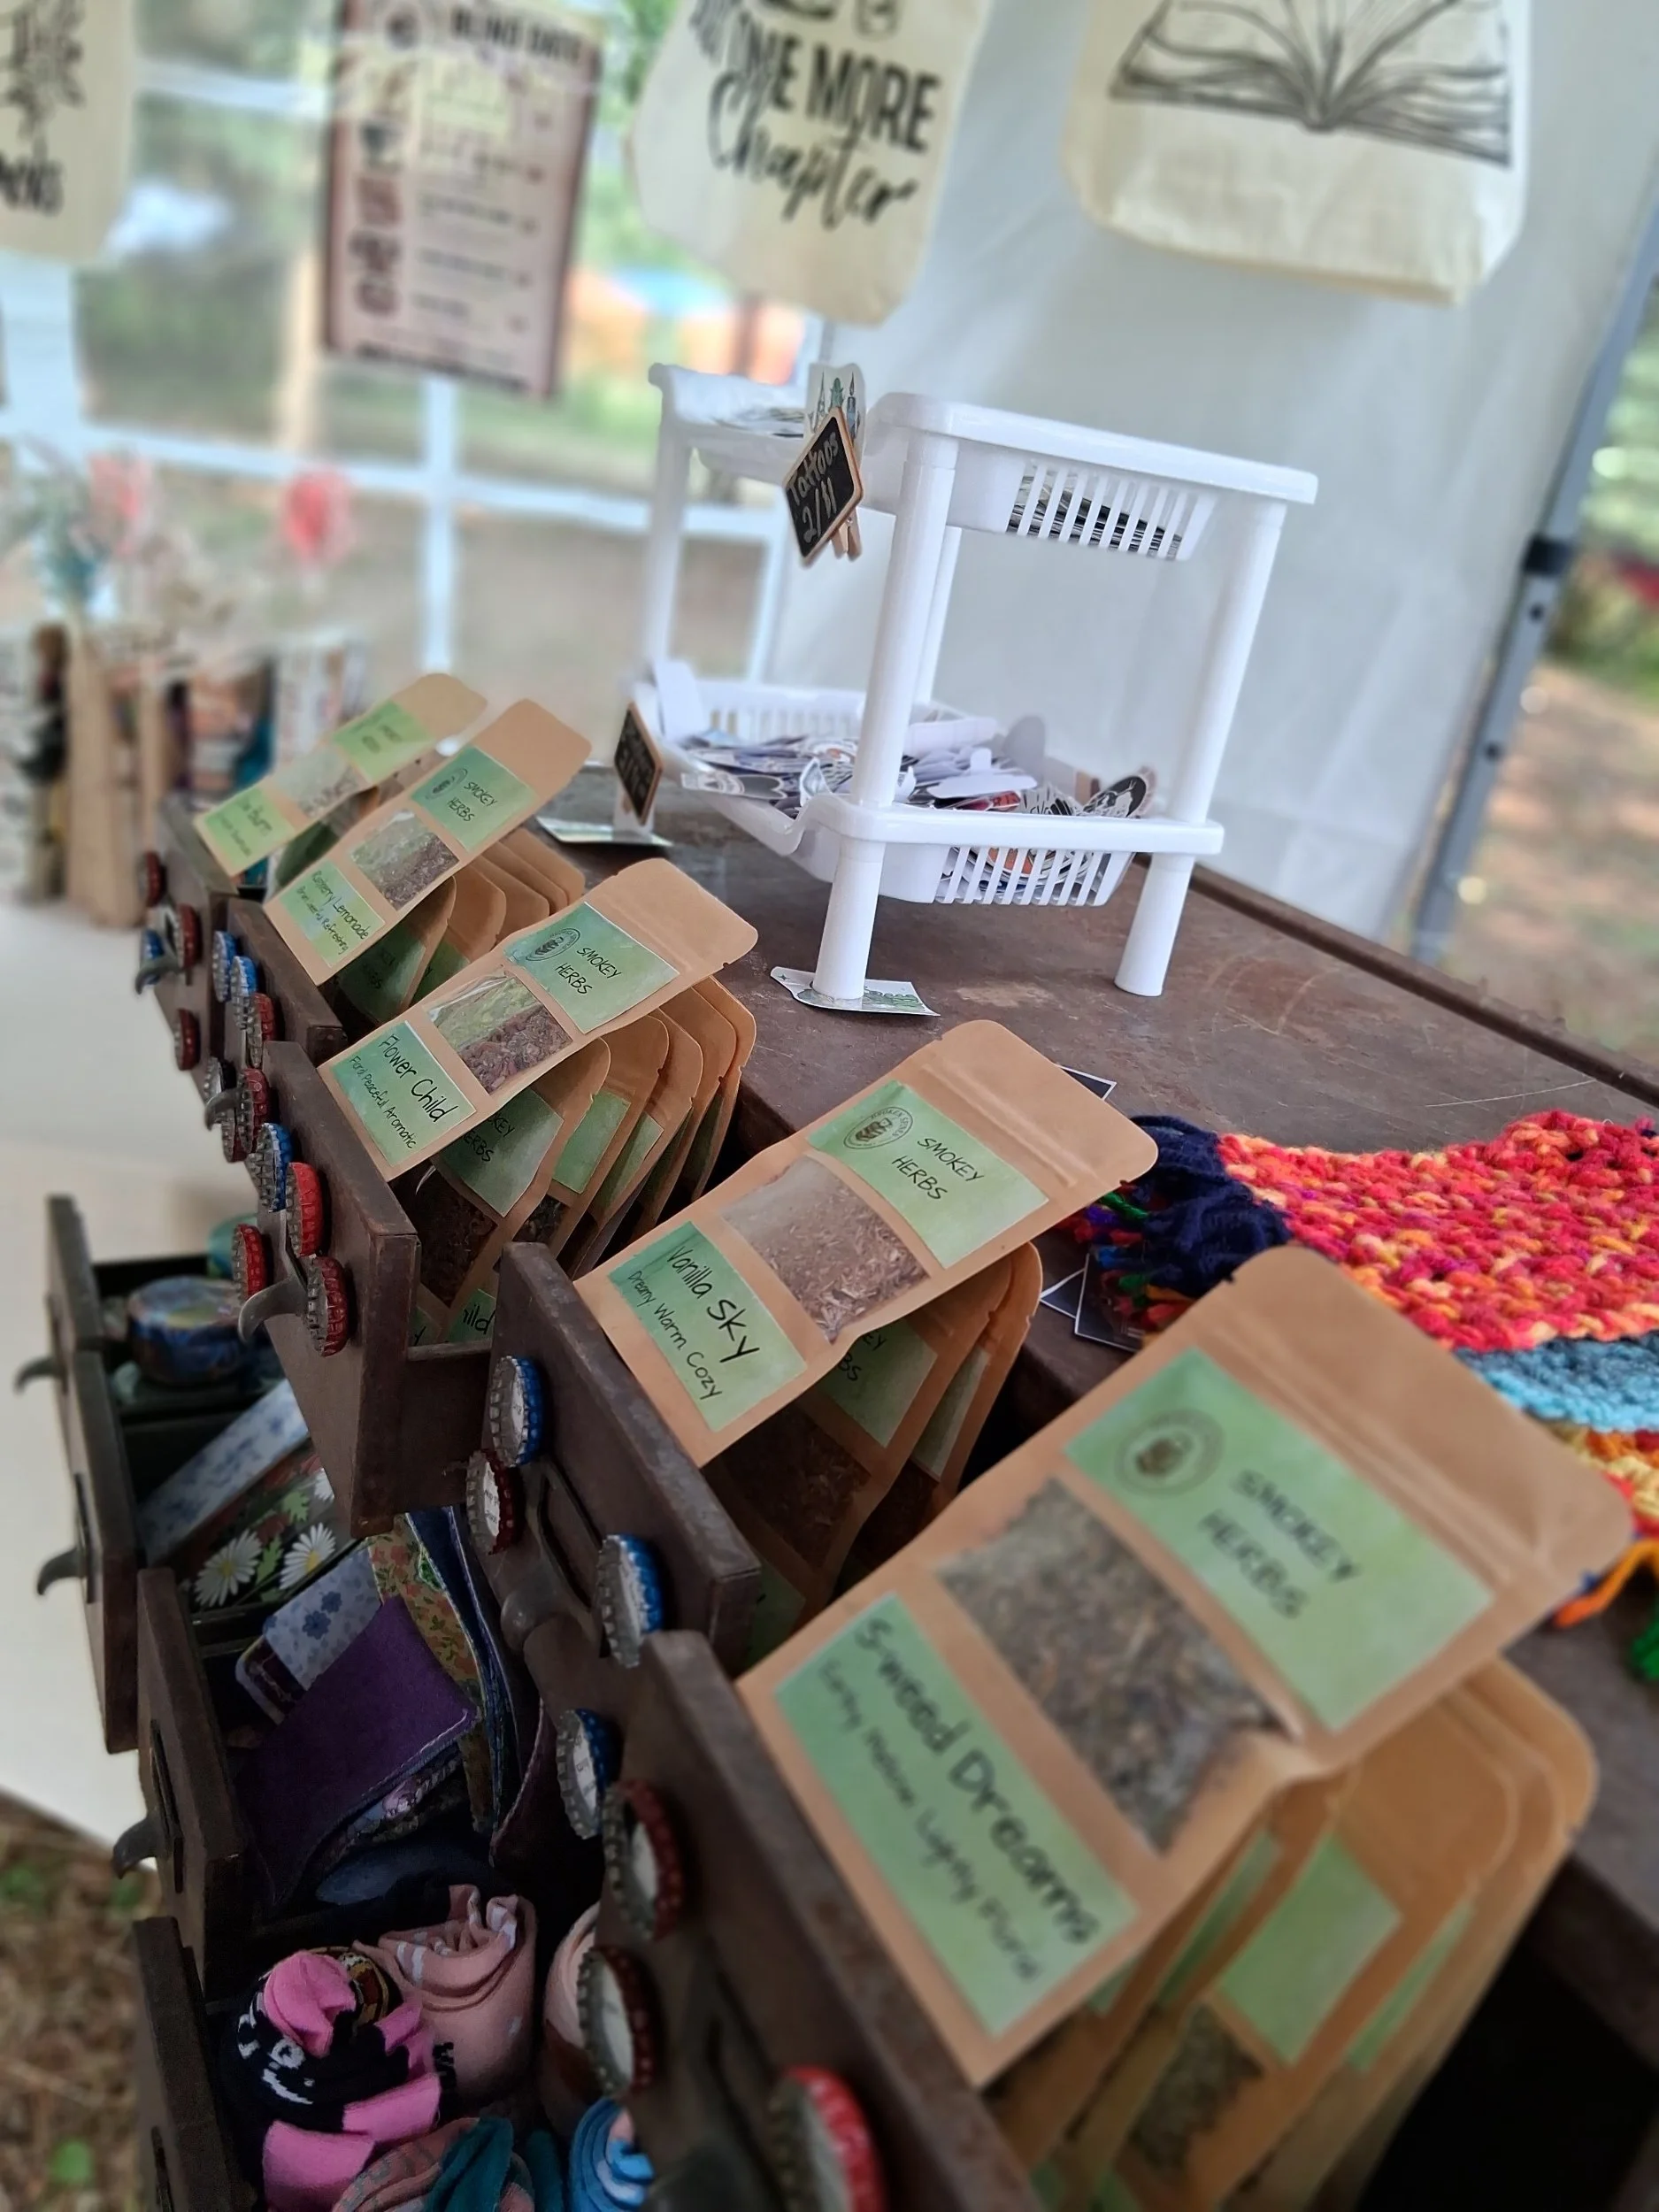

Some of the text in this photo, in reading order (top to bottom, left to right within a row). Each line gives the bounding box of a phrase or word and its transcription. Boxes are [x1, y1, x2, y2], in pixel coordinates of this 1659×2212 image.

[805, 41, 943, 154] MORE
[705, 69, 922, 232] Chapter
[786, 432, 839, 506] Tattoos
[447, 797, 475, 822] HERBS
[464, 781, 497, 807] SMOKEY
[333, 895, 372, 940] Lemonade
[554, 963, 593, 995] HERBS
[576, 947, 622, 979] SMOKEY
[378, 1033, 417, 1079] Flower
[411, 1079, 459, 1123] Child
[361, 1072, 389, 1110] Peaceful
[382, 1106, 417, 1149] Aromatic
[891, 1155, 949, 1200] HERBS
[917, 1138, 985, 1182] SMOKEY
[666, 1246, 713, 1299] Vanilla
[687, 1351, 723, 1401] Cozy
[1228, 1468, 1363, 1583] SMOKEY
[1196, 1508, 1310, 1619] HERBS
[949, 1749, 1100, 1945] Dreams
